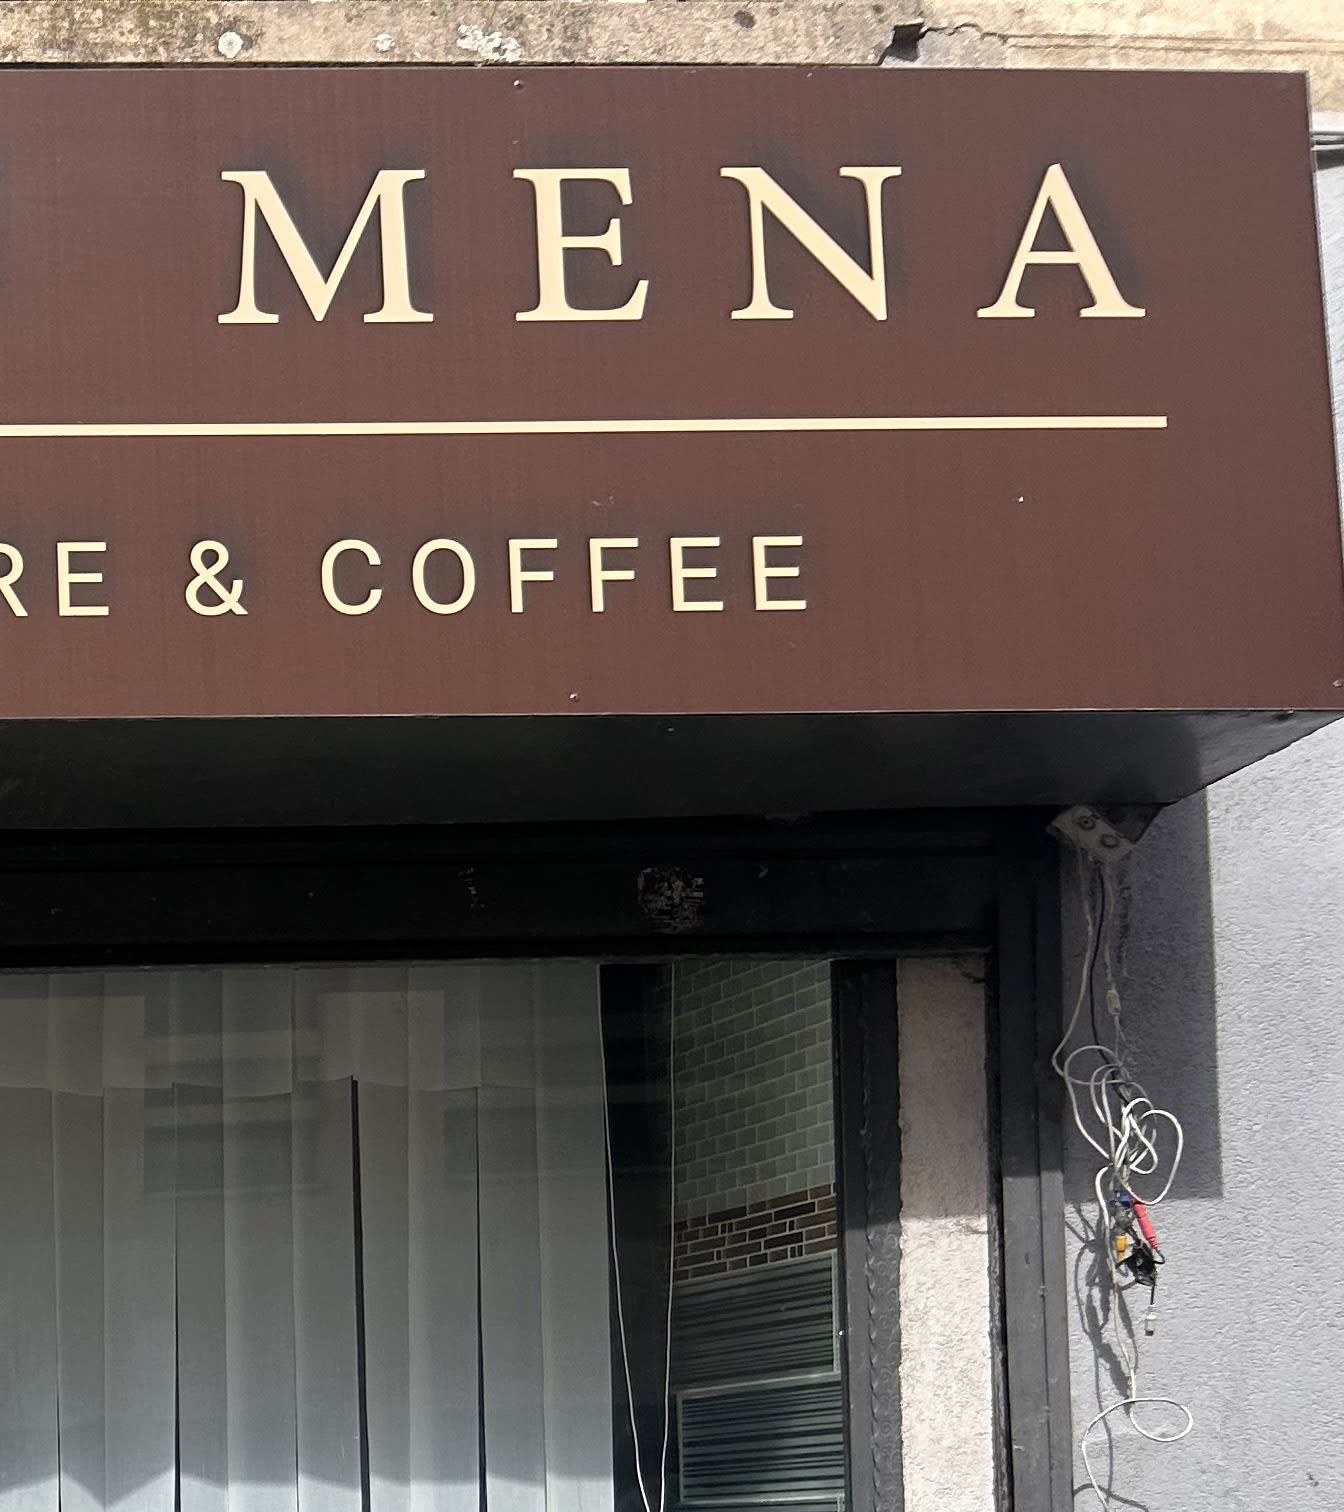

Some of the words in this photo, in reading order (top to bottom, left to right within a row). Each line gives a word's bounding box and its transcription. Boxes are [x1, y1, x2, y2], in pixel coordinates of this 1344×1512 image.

[217, 163, 1147, 325] MENA
[183, 538, 249, 617] &
[319, 535, 807, 615] COFFEE
